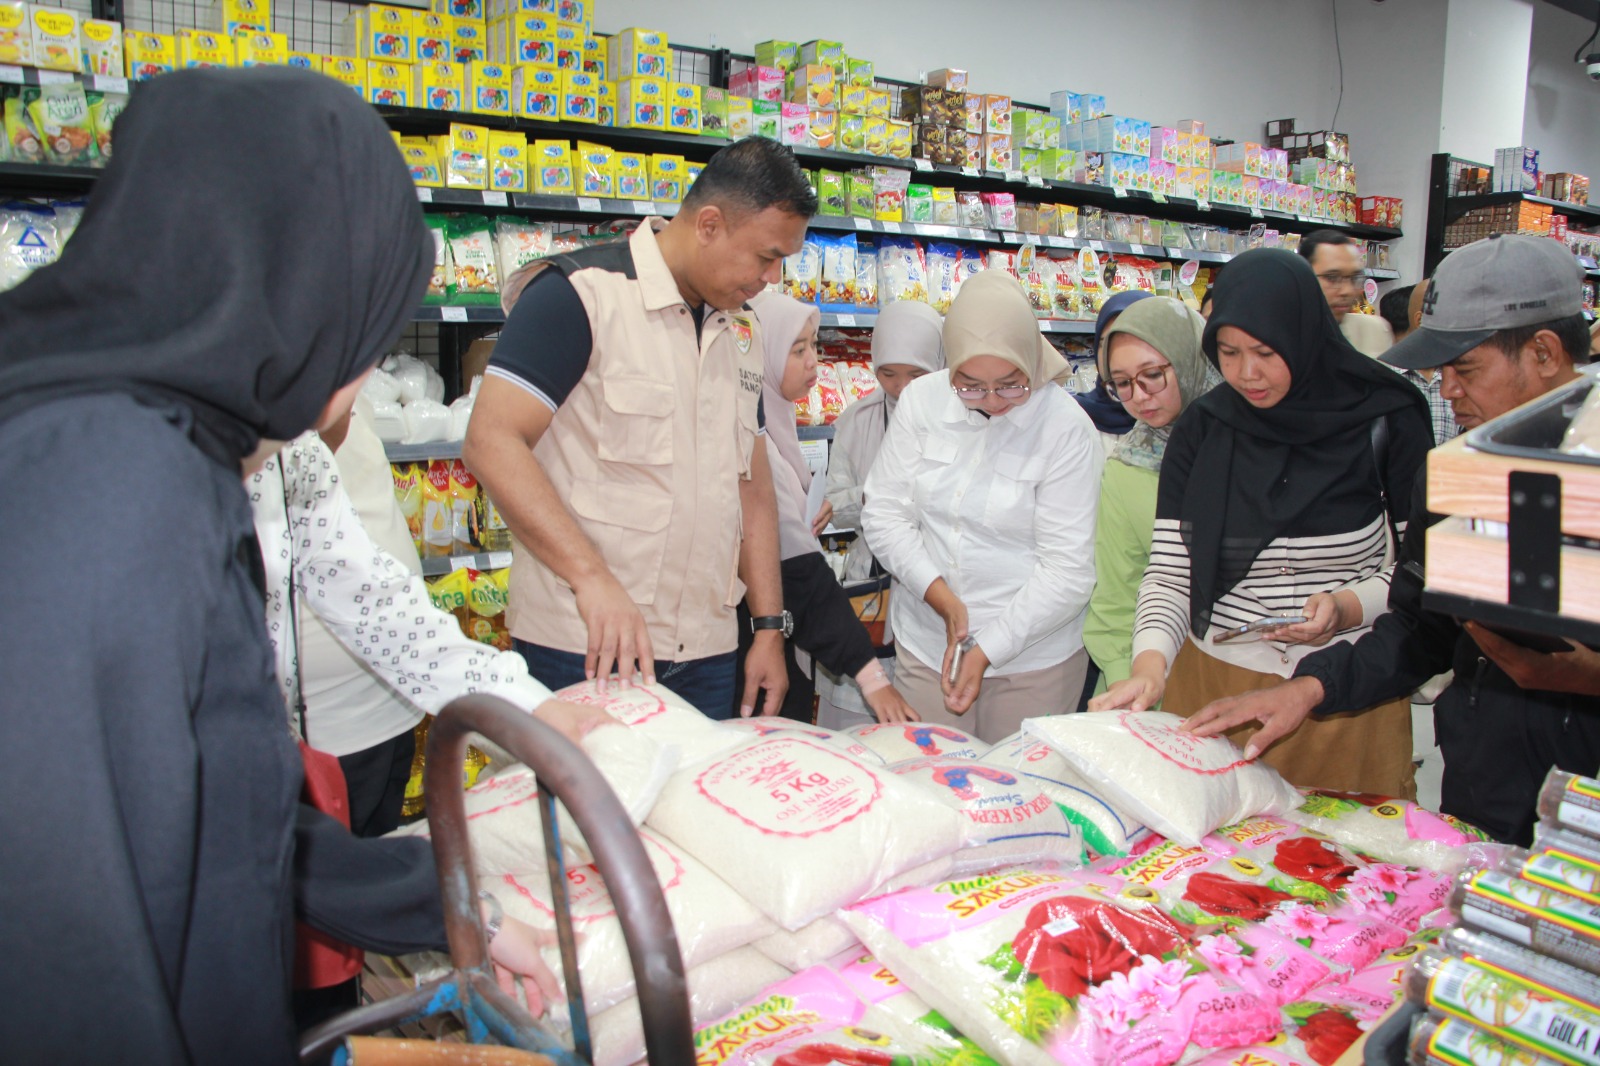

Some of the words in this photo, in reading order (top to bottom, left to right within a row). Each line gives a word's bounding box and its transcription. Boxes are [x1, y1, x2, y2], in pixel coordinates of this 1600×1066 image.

[1503, 303, 1517, 311] LOS
[1520, 300, 1547, 310] ANGELES
[739, 368, 765, 385] SATGA
[431, 591, 465, 608] tra
[470, 585, 508, 604] mitr
[769, 789, 791, 803] 5
[787, 772, 830, 793] Kg
[776, 801, 805, 821] OSE
[803, 775, 855, 807] NALUSU
[566, 869, 587, 885] 5
[1546, 1014, 1589, 1052] GULA
